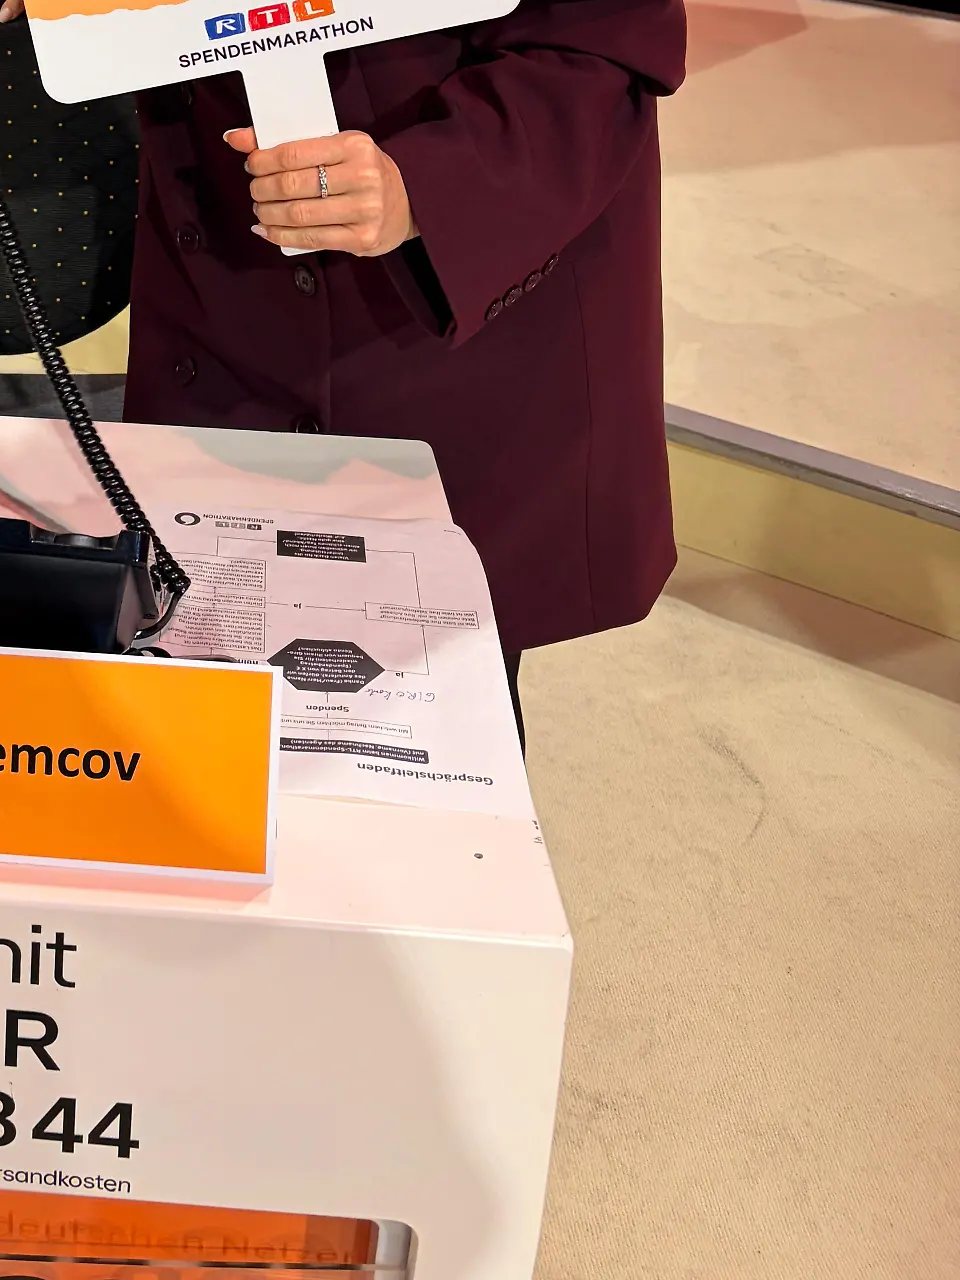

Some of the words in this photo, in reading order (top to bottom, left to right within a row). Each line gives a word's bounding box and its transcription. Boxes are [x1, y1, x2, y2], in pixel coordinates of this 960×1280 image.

[178, 16, 374, 68] SPENDENMARATHON
[203, 513, 274, 524] SPENDENMARATHON
[305, 704, 350, 713] Spenden
[381, 751, 425, 762] Willkommen
[357, 763, 493, 786] Gesprächsleitfaden
